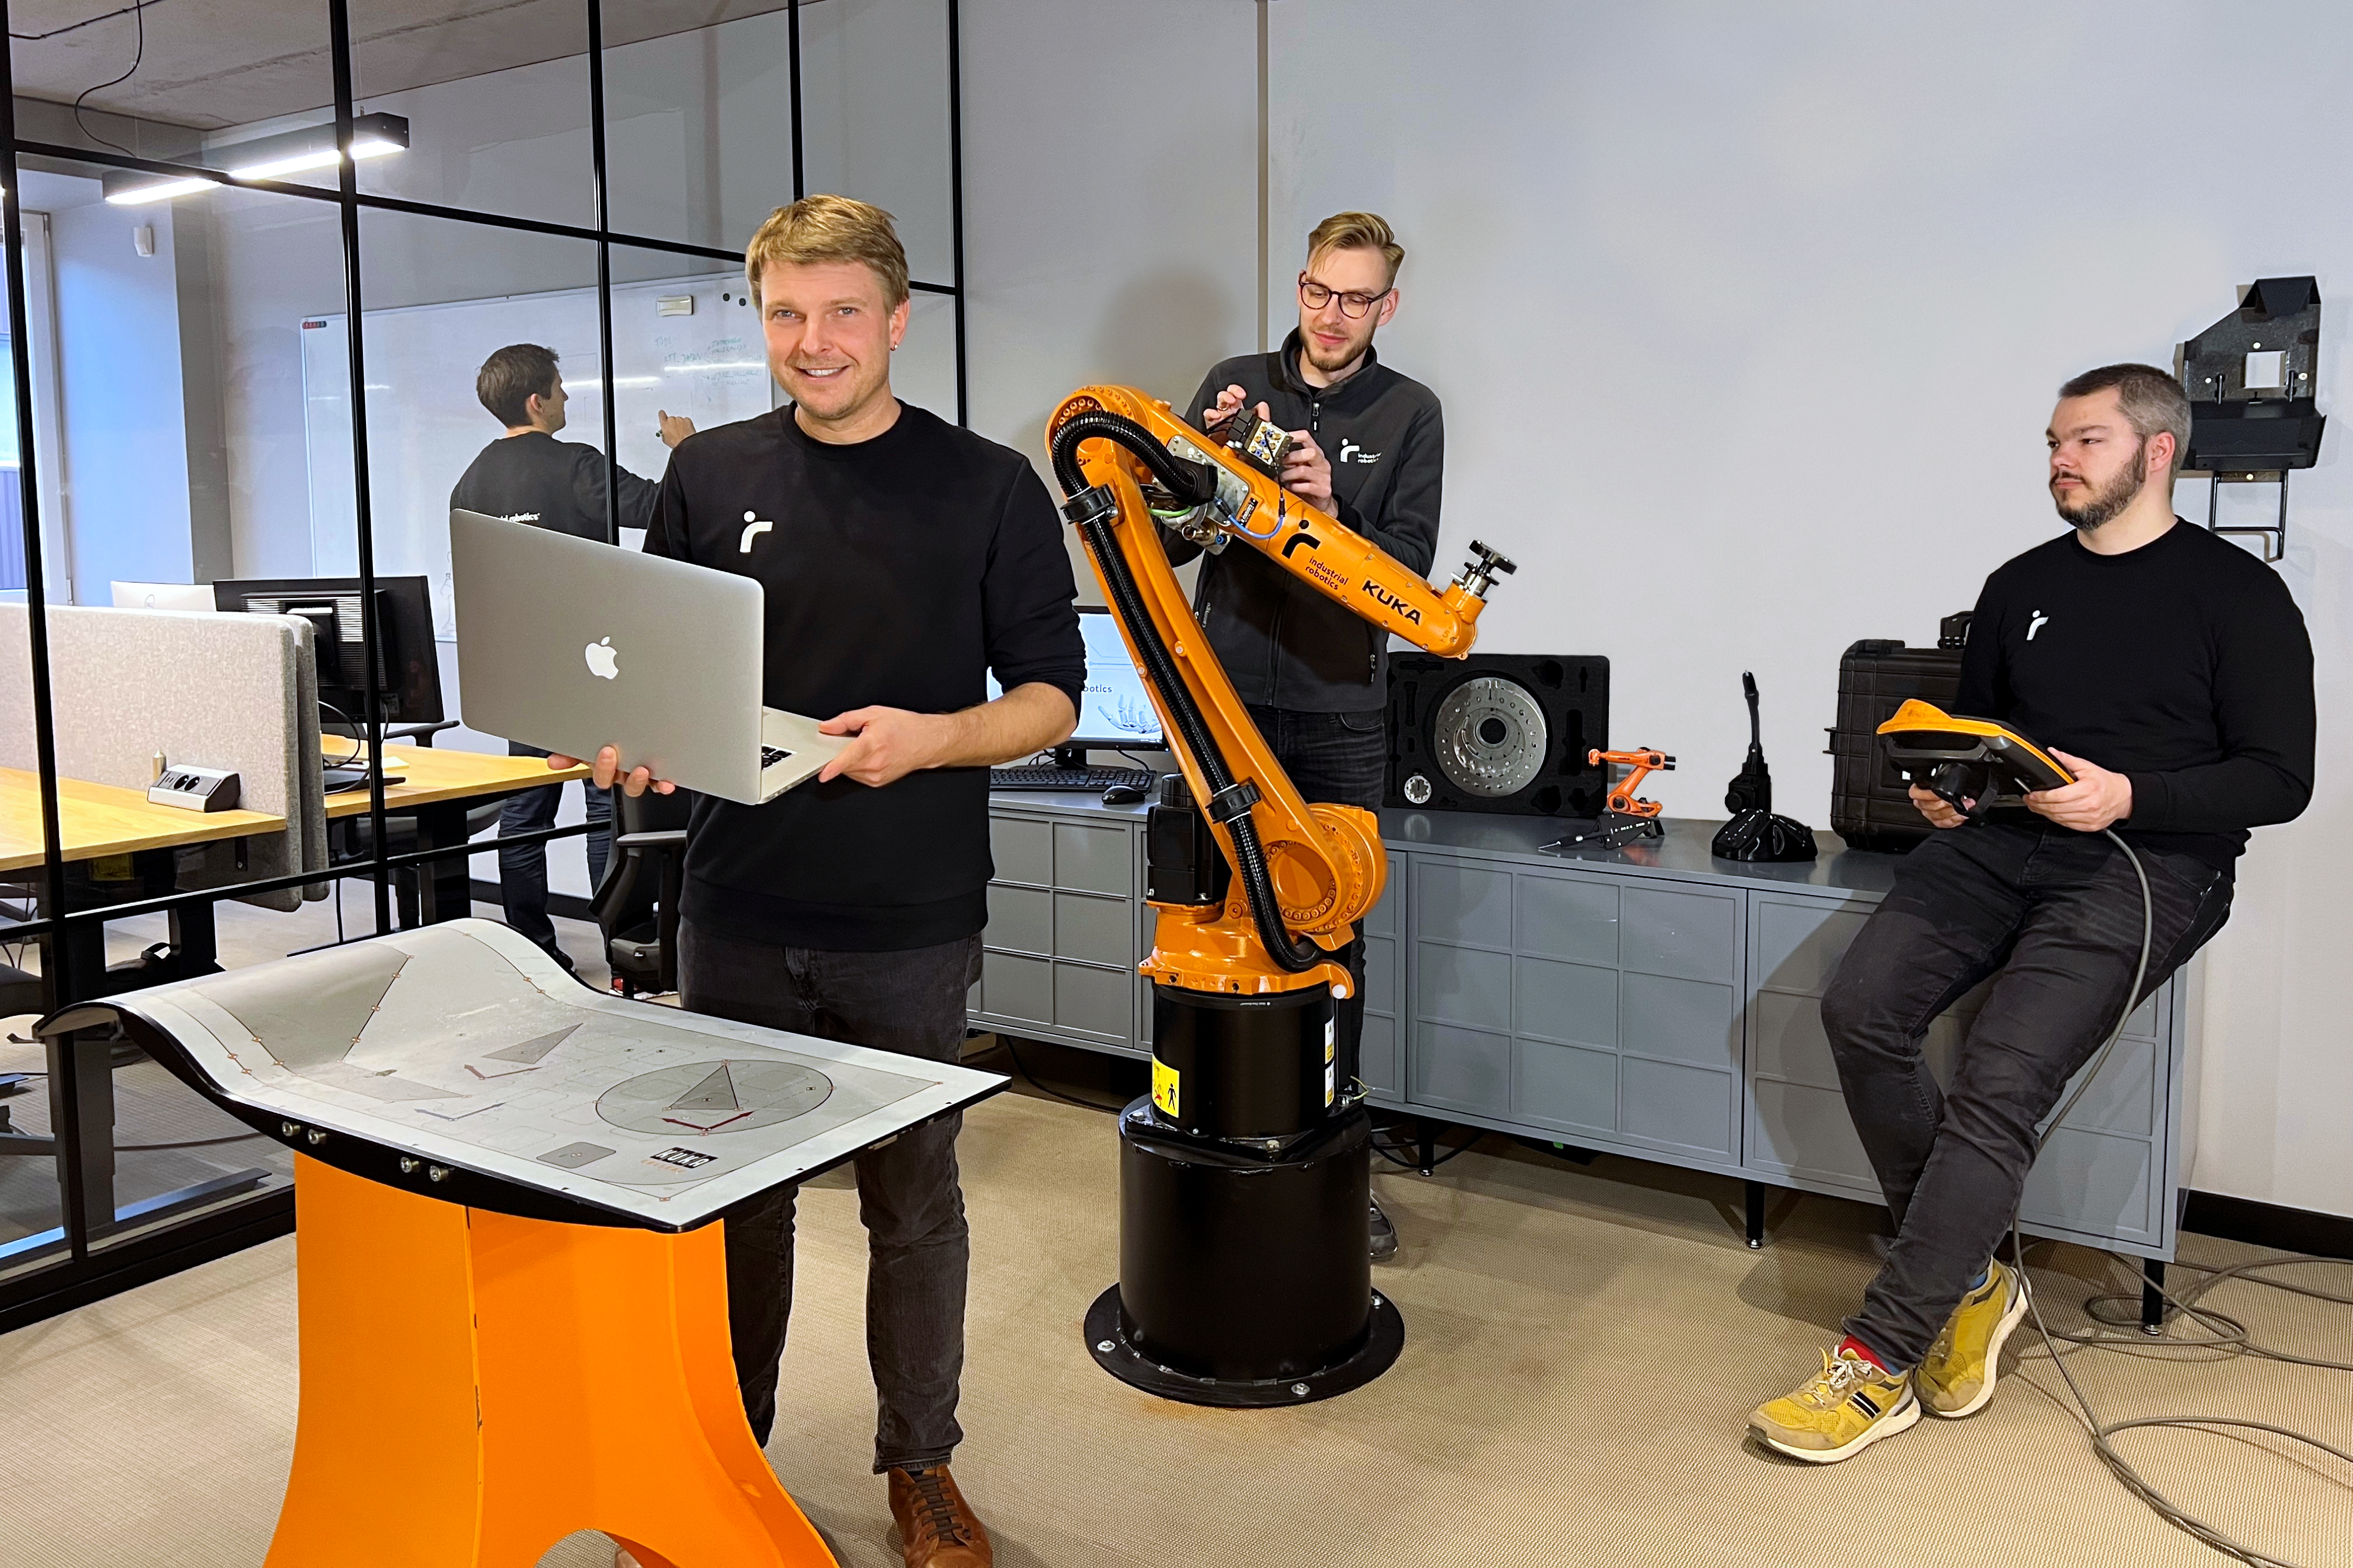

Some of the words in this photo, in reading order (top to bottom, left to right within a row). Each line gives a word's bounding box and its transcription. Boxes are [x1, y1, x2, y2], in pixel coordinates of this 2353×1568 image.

[1305, 566, 1339, 590] robotics
[1309, 555, 1349, 585] industrial
[1362, 580, 1421, 626] KUKA
[655, 1149, 710, 1167] KUKA
